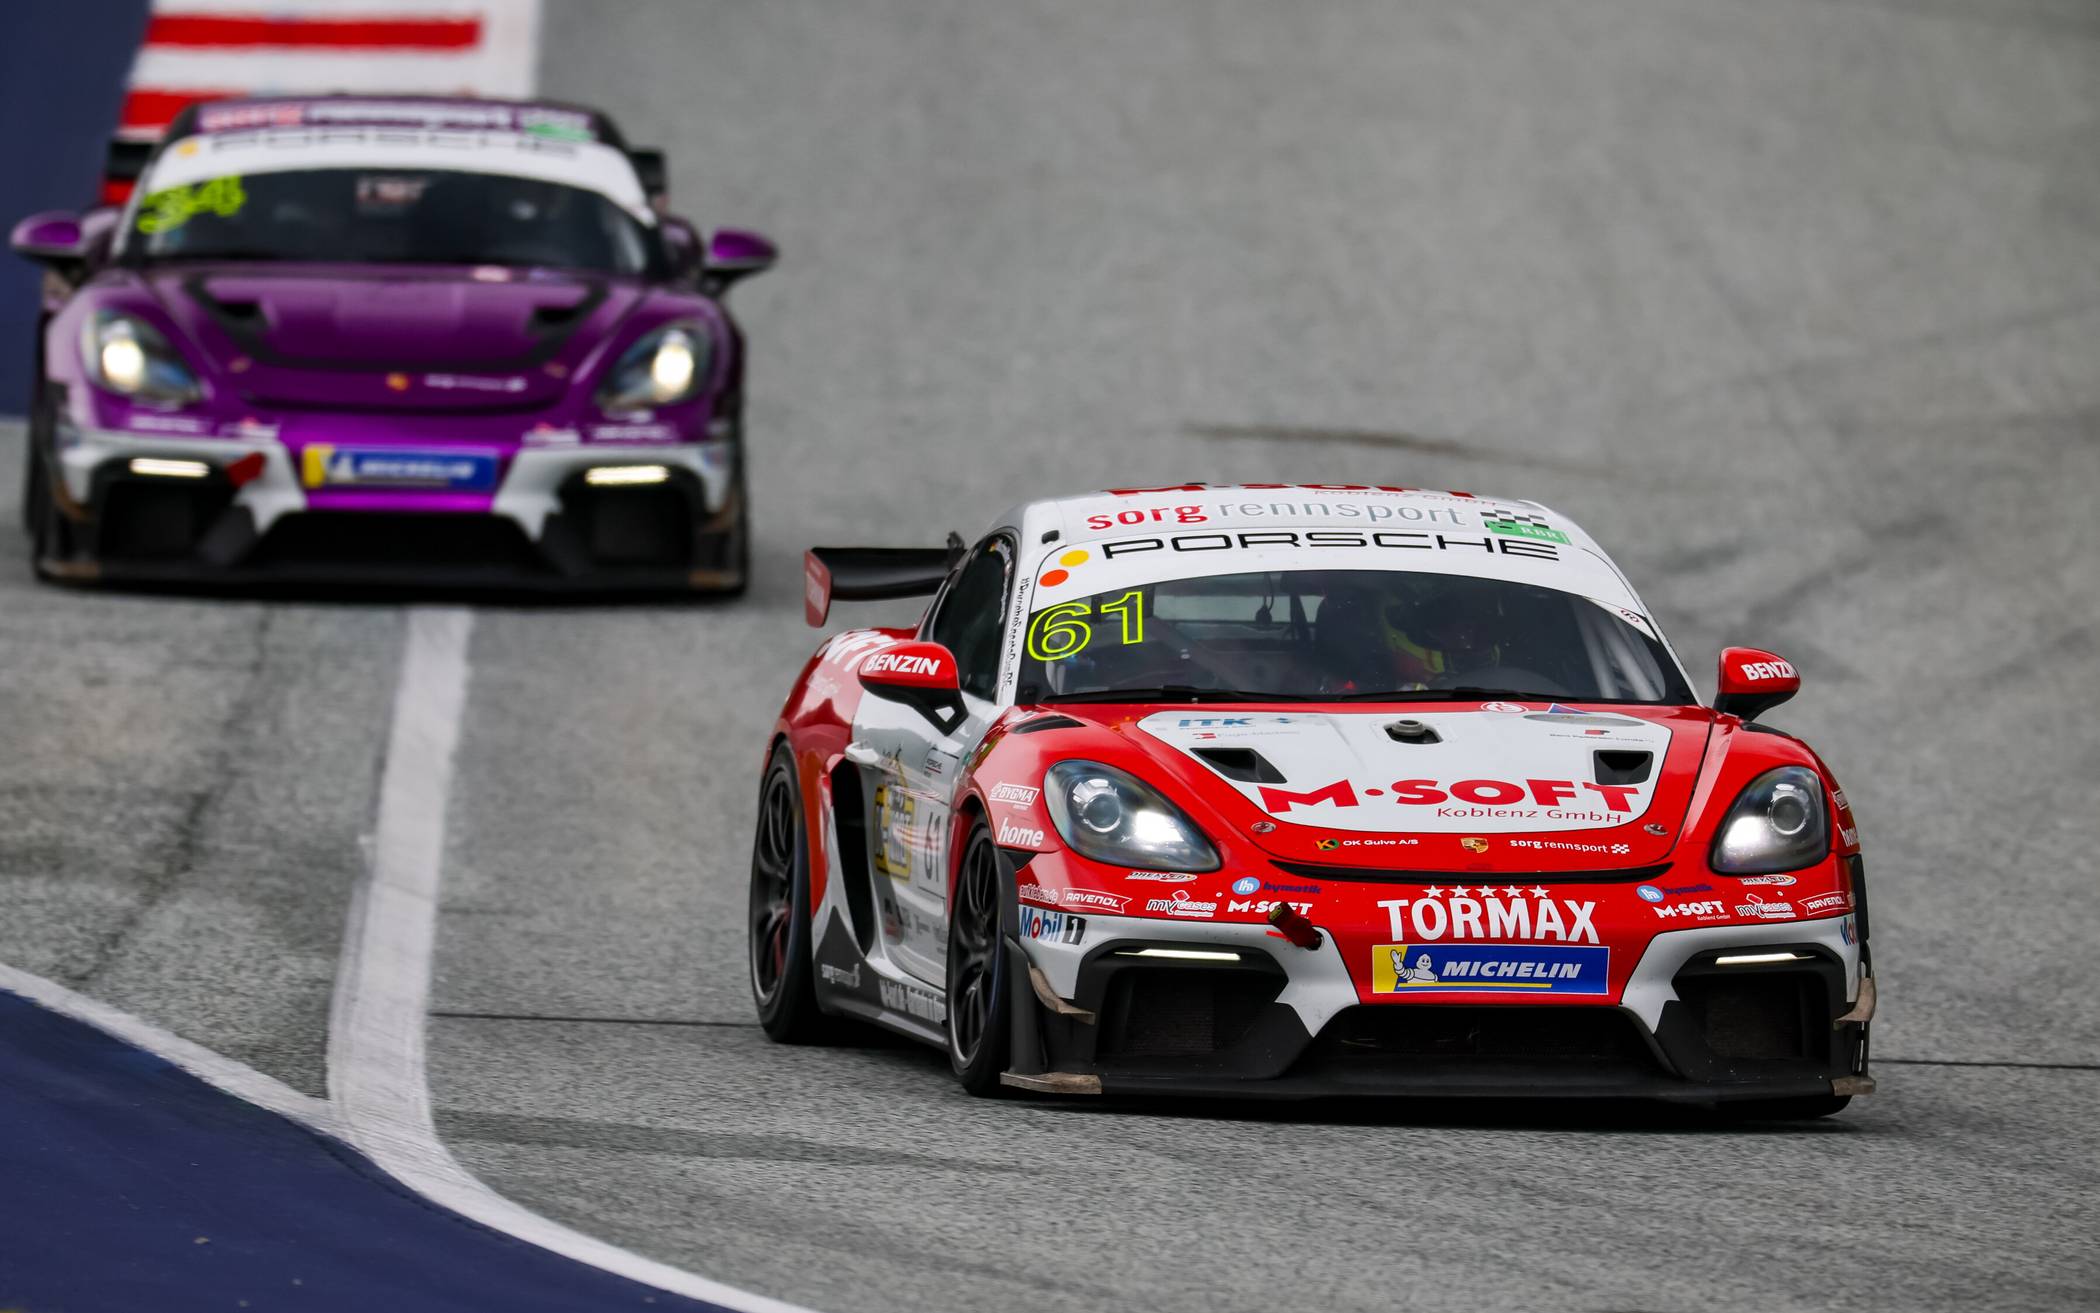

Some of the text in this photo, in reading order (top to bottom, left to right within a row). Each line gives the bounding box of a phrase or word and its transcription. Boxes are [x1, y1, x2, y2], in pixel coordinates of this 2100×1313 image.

[1087, 503, 1468, 530] sorg rennsport
[1102, 532, 1559, 561] PORSCHE
[1027, 591, 1143, 661] 61
[865, 654, 941, 676] BENZIN
[1178, 718, 1254, 727] ITK
[998, 786, 1034, 802] BYGMA
[1437, 807, 1622, 823] Koblenz GmbH
[998, 817, 1045, 847] home
[1510, 839, 1608, 854] sorg rennsport
[1065, 892, 1120, 907] RAVENOL
[1807, 896, 1845, 911] RAVENOL
[1020, 907, 1079, 943] Mobil 1
[1377, 897, 1600, 944] TORMAX
[1442, 960, 1582, 979] MICHELIN
